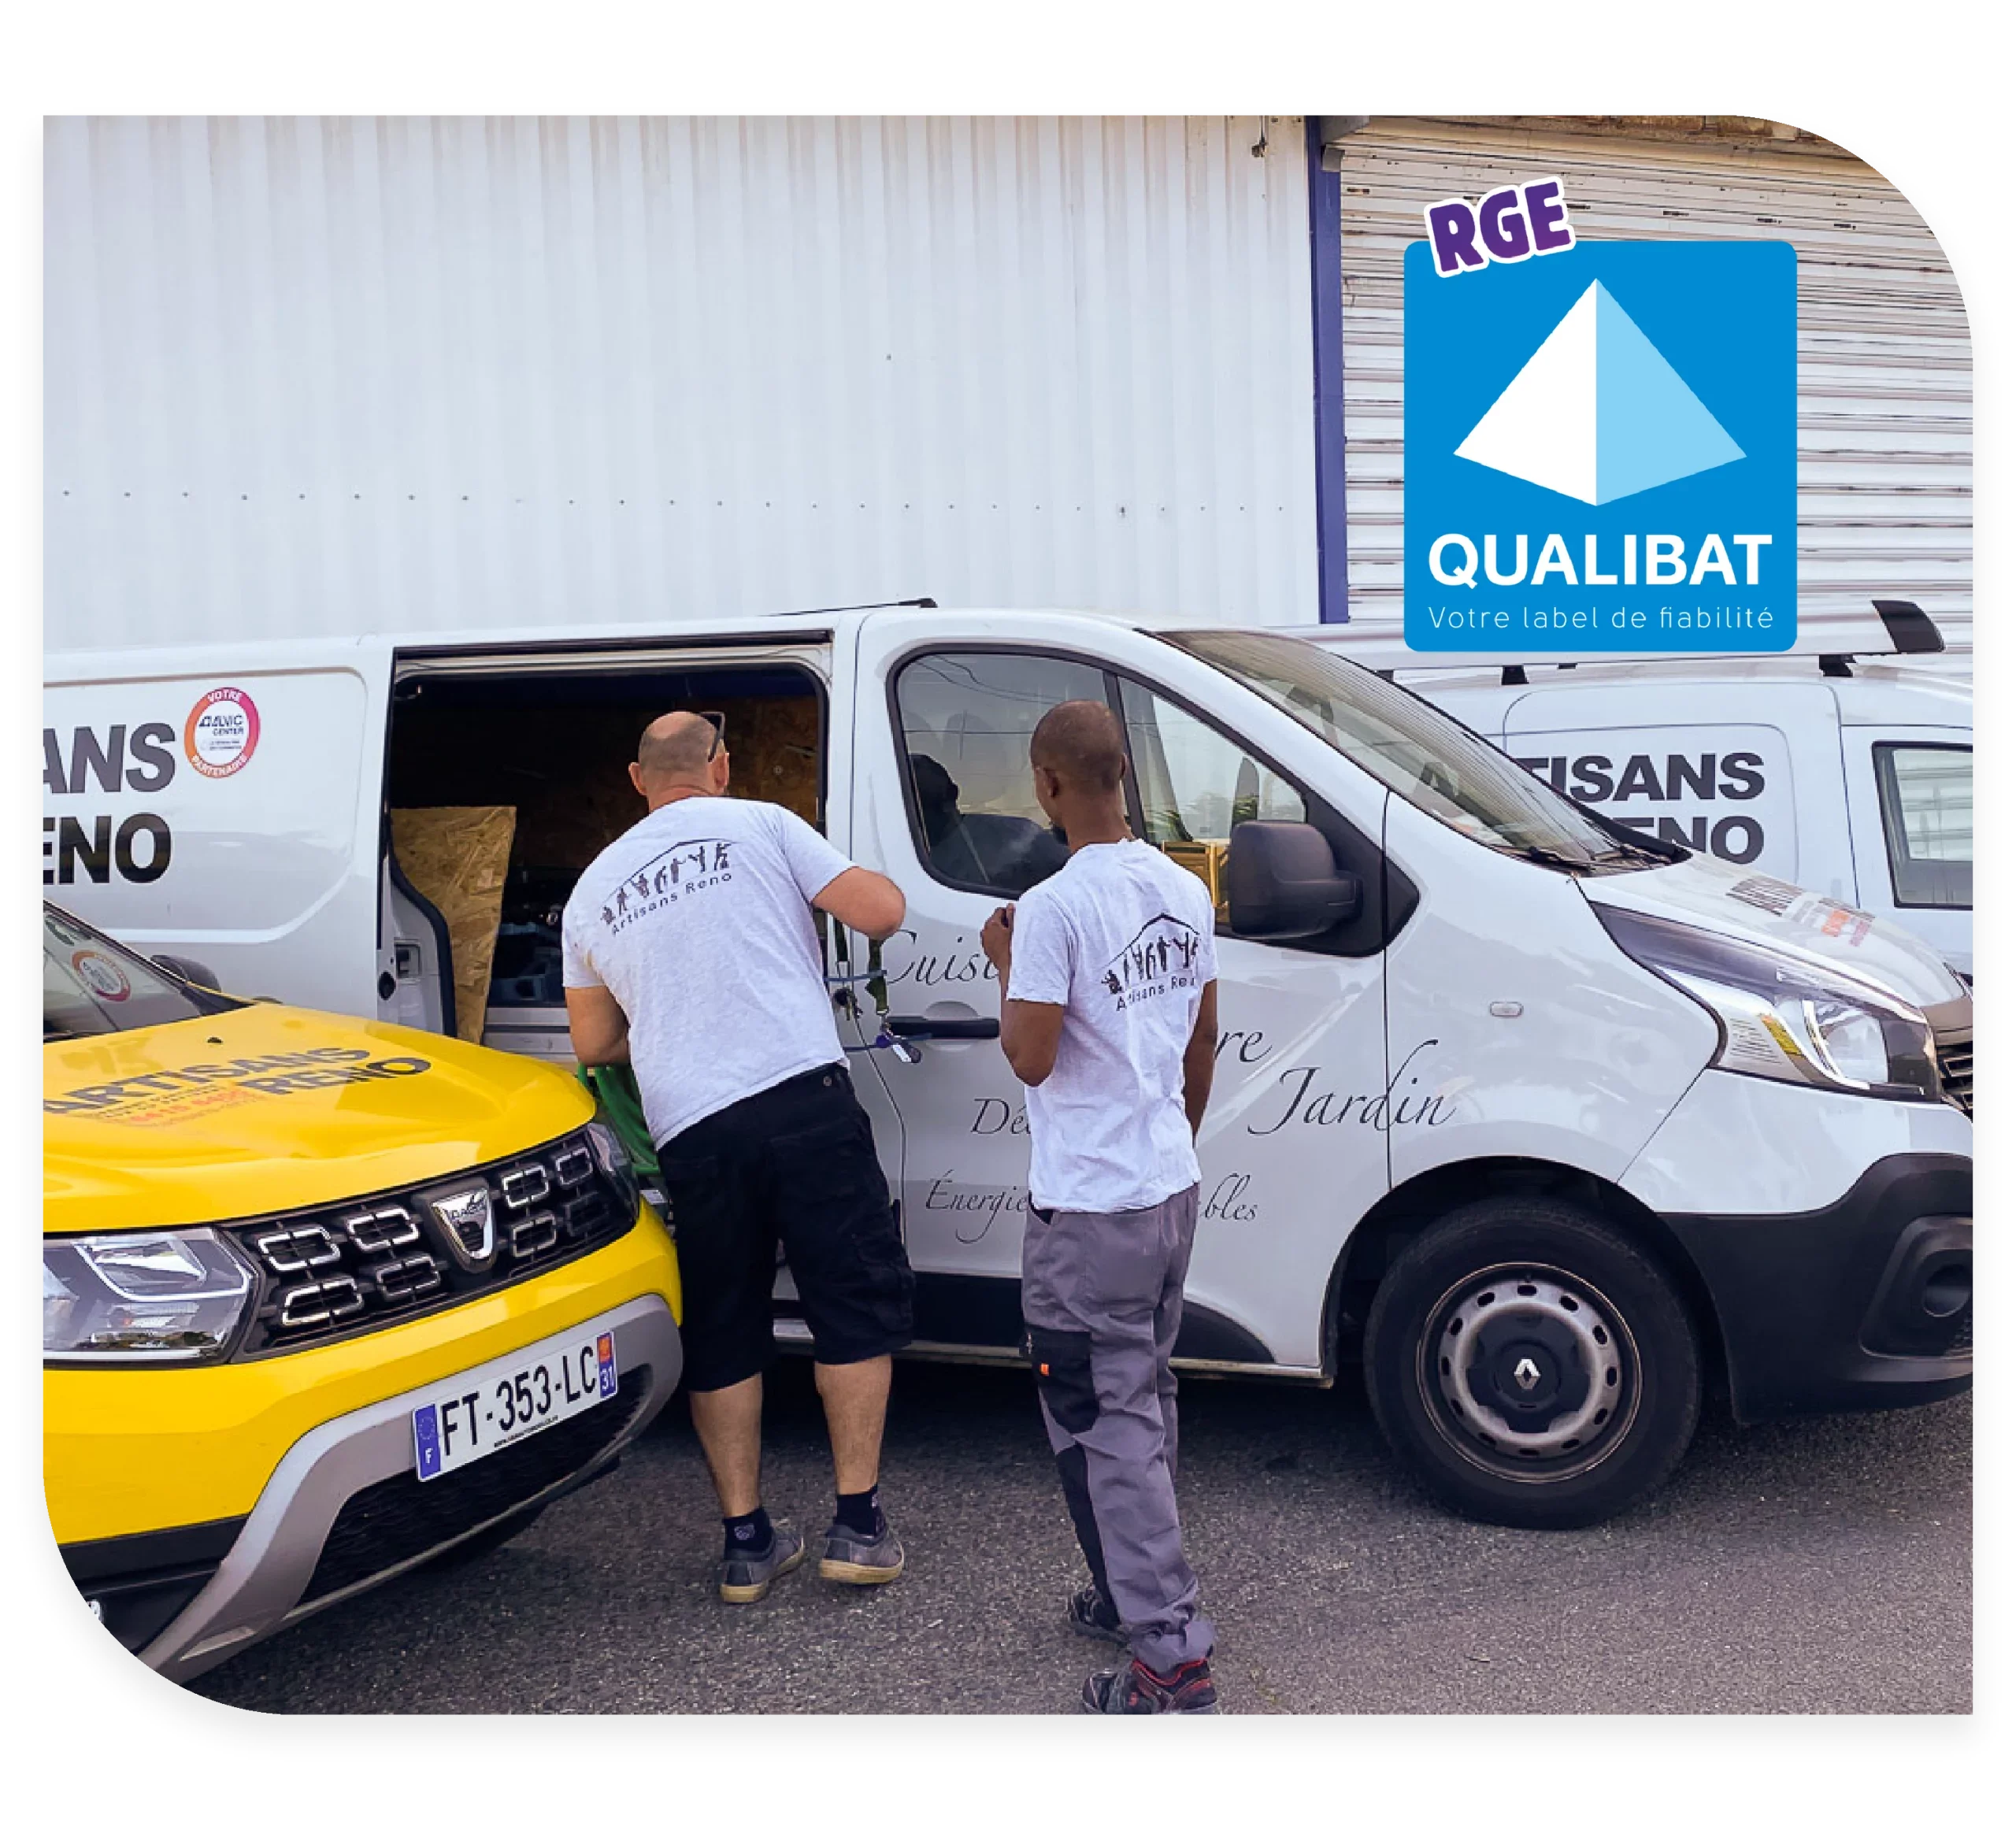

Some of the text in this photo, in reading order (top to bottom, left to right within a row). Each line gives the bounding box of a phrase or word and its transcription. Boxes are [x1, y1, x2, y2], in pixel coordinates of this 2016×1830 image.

[43, 813, 172, 885] NO
[611, 872, 732, 937] Artisans Reno
[235, 1057, 432, 1095] RENO
[1214, 1030, 1273, 1063] re
[43, 1048, 371, 1113] ARTISANS
[1247, 1039, 1458, 1135] Jardin
[424, 1447, 433, 1465] F
[440, 1346, 597, 1457] FT-353-LC
[600, 1365, 615, 1391] 31
